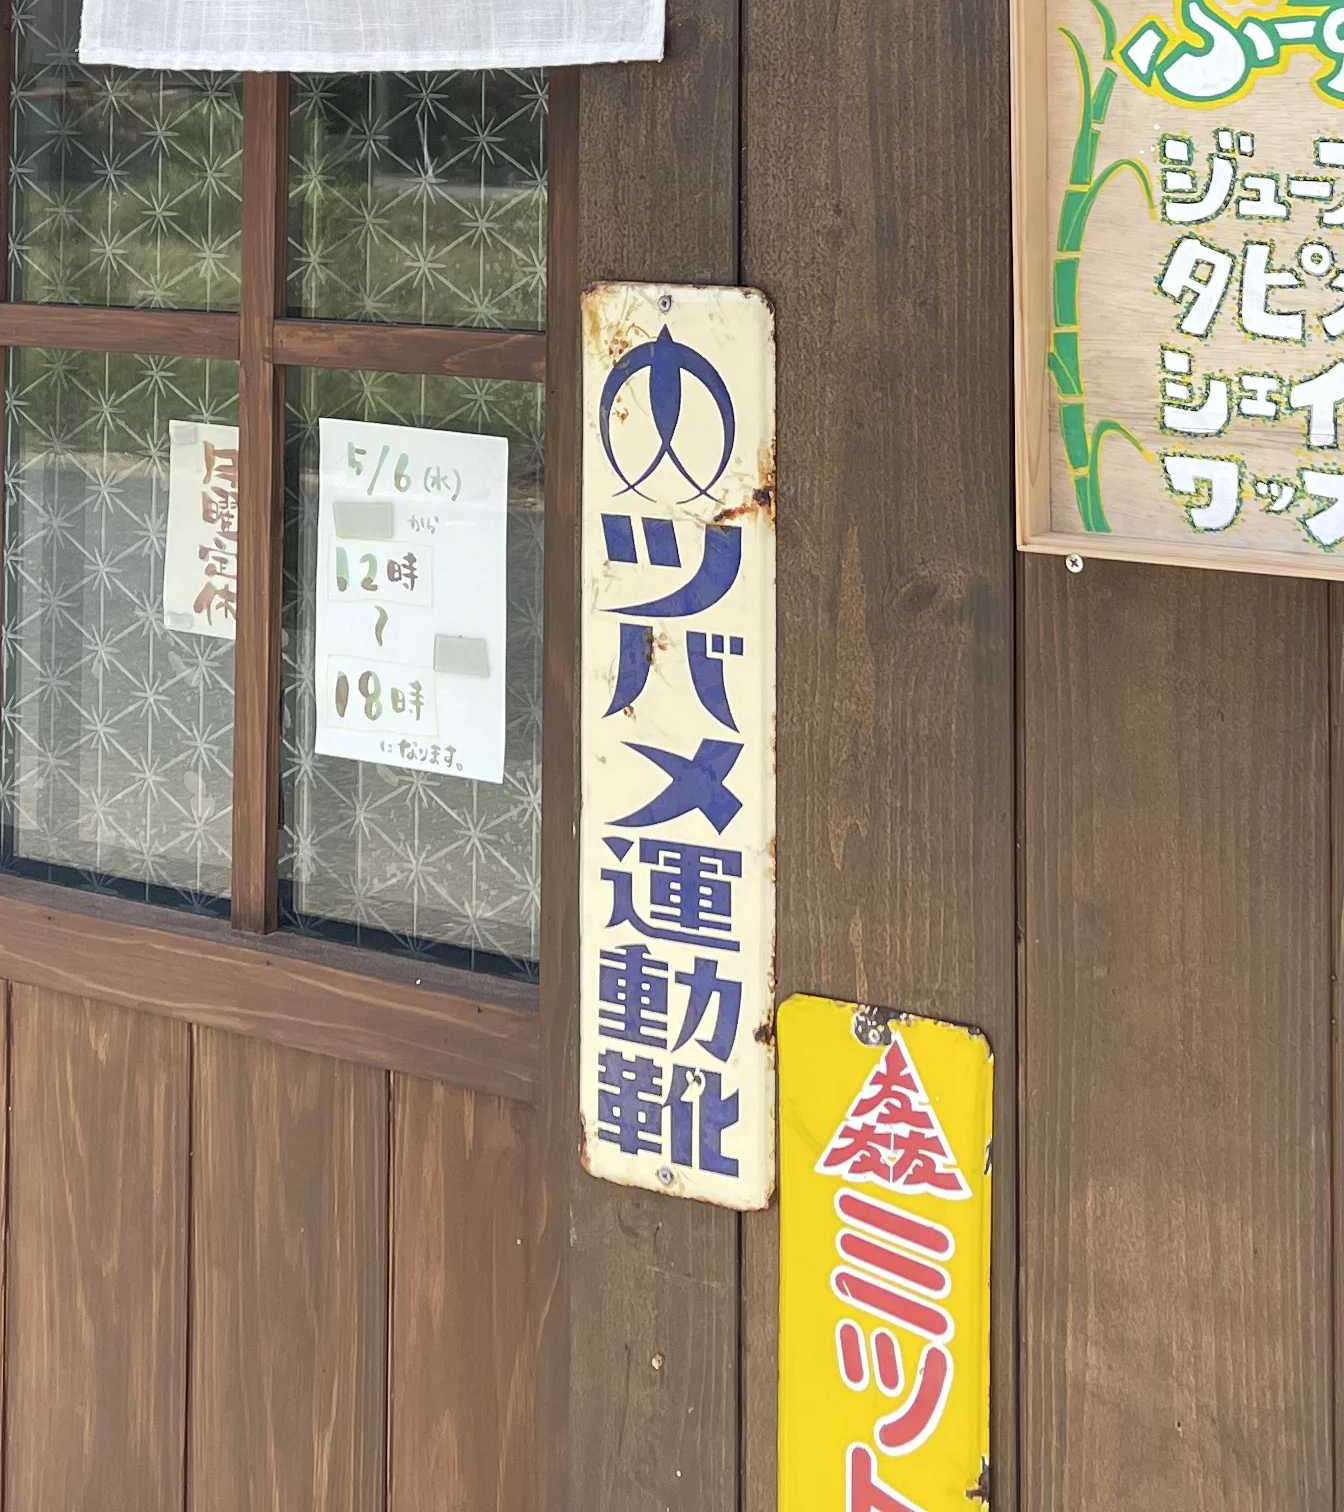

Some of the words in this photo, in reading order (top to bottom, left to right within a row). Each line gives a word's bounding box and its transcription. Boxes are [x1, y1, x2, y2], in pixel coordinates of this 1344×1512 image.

[408, 514, 439, 535] から
[336, 546, 420, 593] 12時
[336, 670, 425, 722] 18時
[597, 512, 743, 1180] ツバメ運動靴
